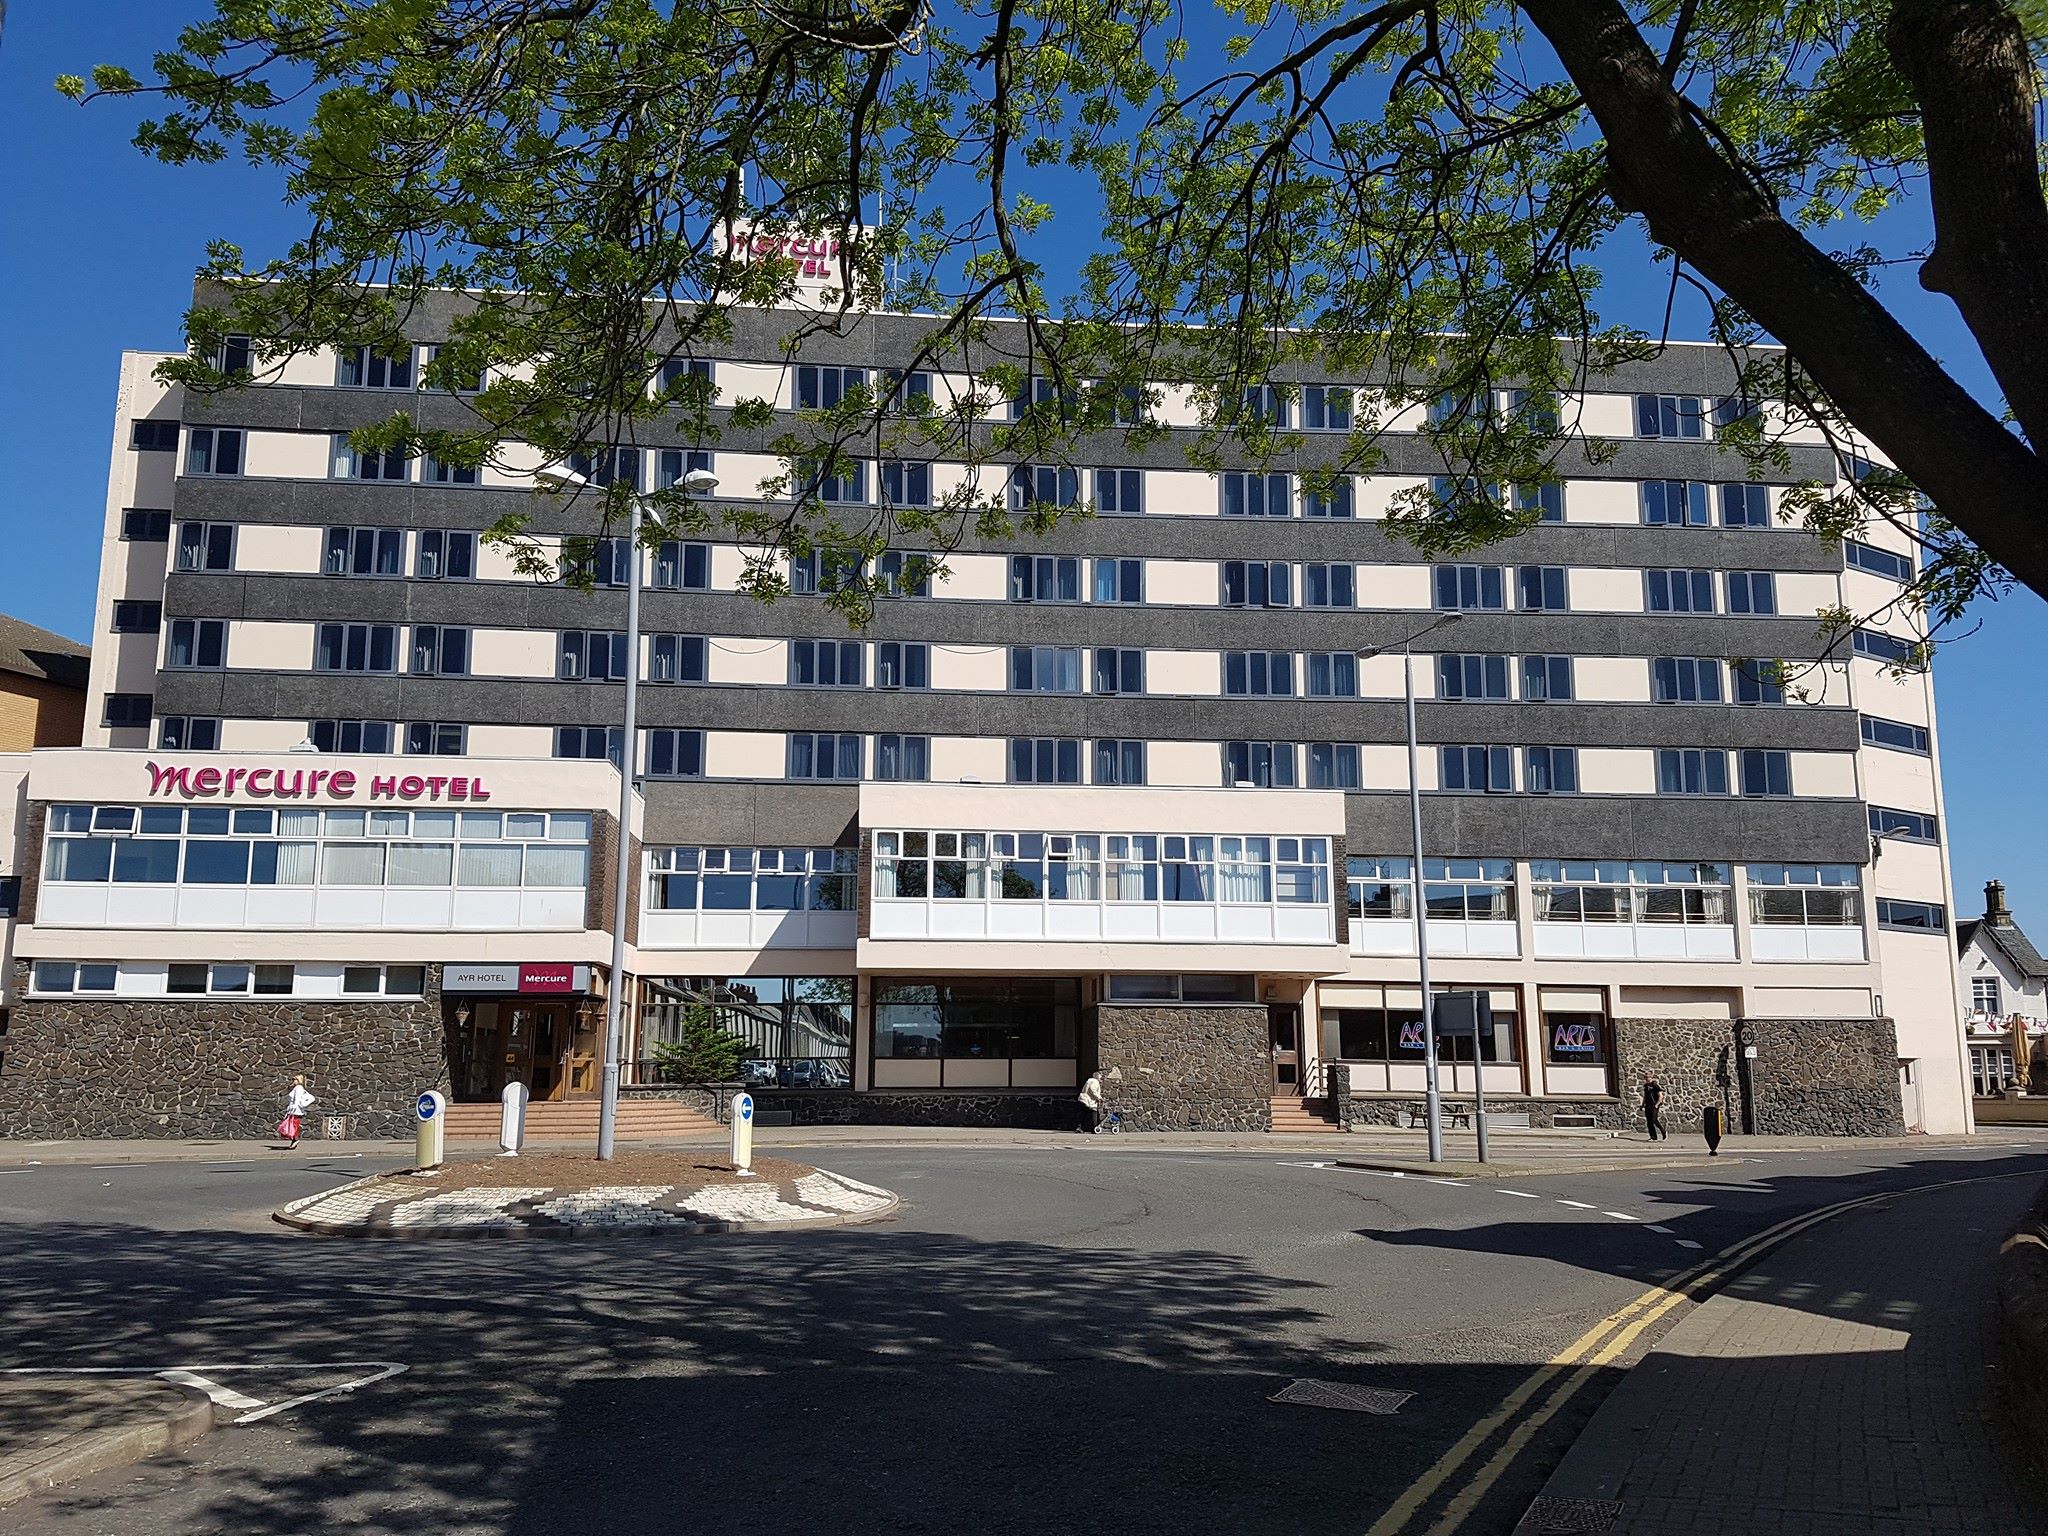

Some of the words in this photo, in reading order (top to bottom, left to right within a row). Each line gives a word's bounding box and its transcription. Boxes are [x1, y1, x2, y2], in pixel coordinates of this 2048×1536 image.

[371, 775, 491, 800] HOTEL
[457, 974, 475, 982] AYR
[477, 974, 506, 982] HOTEL
[525, 975, 568, 983] Mercure
[1554, 1024, 1596, 1047] ARTS
[1742, 1031, 1753, 1041] 20
